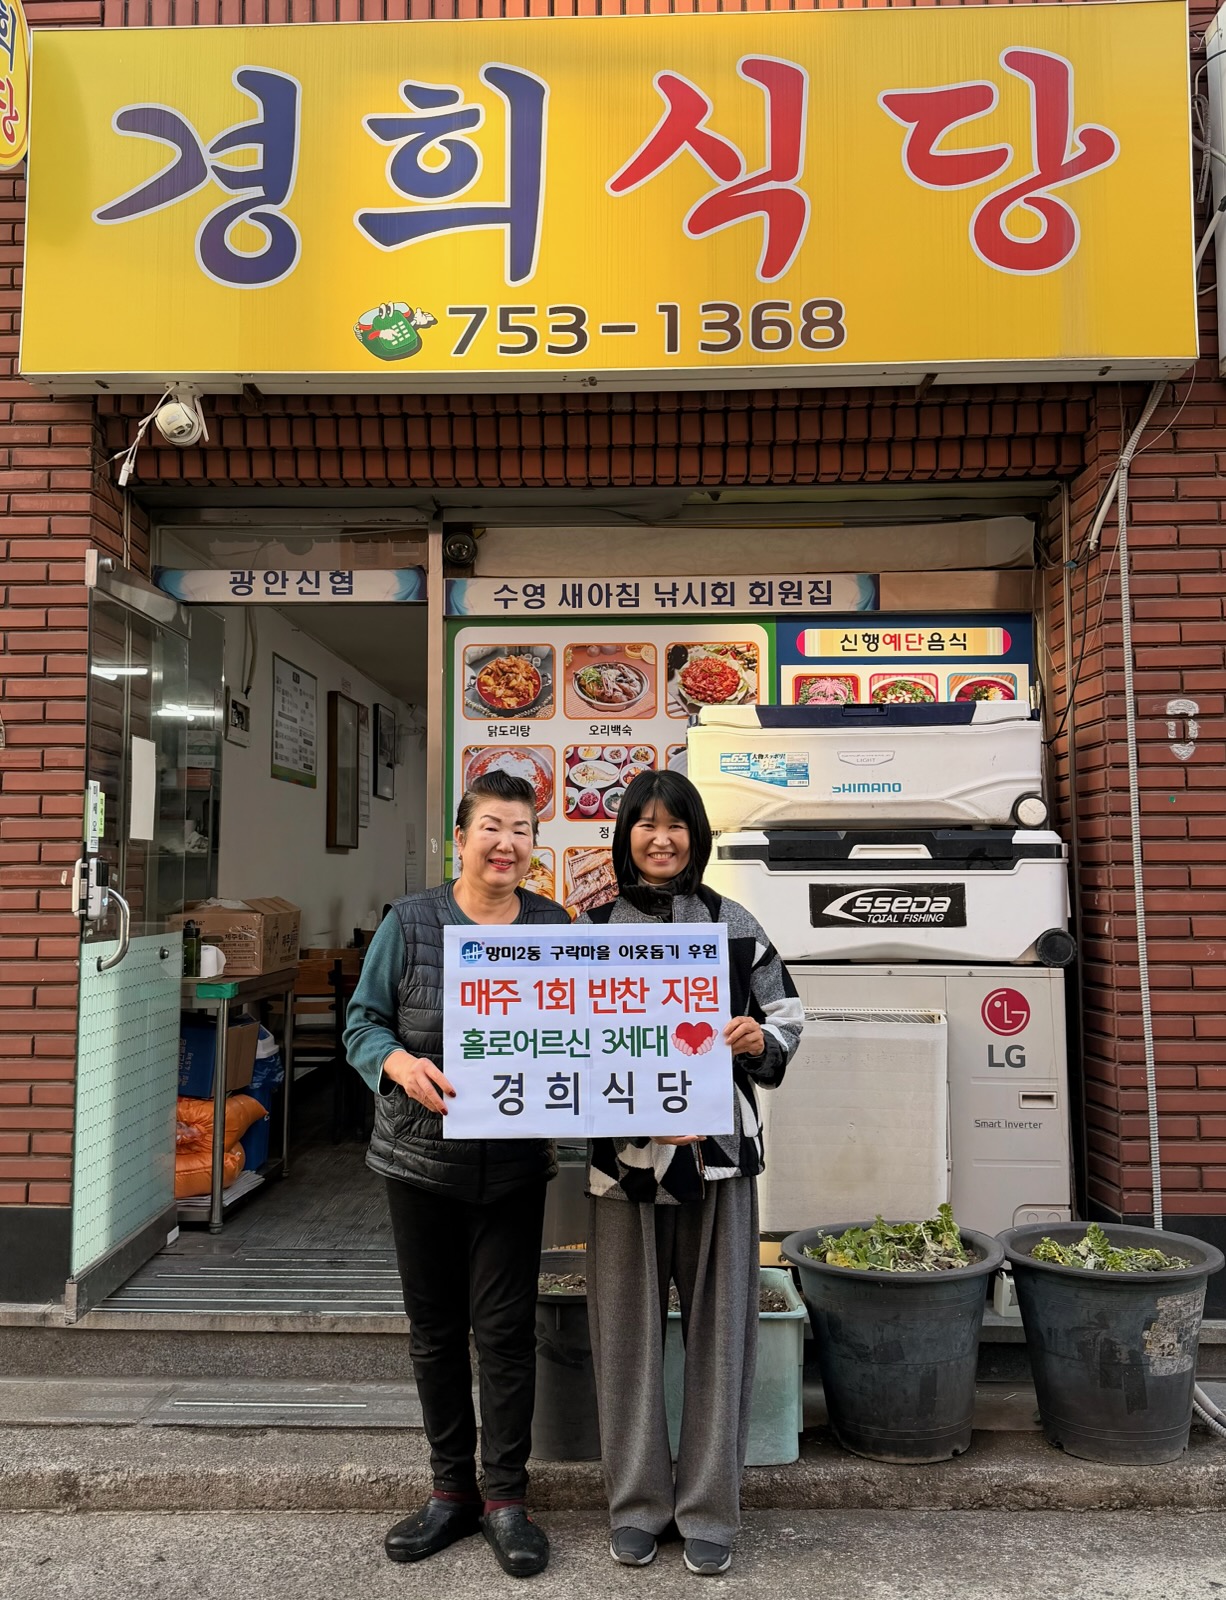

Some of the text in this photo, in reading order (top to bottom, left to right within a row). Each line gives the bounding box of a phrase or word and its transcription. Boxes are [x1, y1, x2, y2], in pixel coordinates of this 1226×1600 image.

[92, 46, 1120, 289] 경희식당
[447, 298, 846, 356] 753-1368
[229, 570, 353, 596] 광안신협
[493, 580, 832, 609] 수영 새아침 낚시회 회원집
[840, 632, 967, 652] 신행예단음식
[487, 724, 633, 737] 닭도리탕 오리백숙
[832, 782, 902, 793] SHIMANO
[599, 826, 616, 839] 정
[868, 914, 945, 923] TOTAL FISHING
[485, 944, 717, 961] 망미2동 구락마을 이웃돕기 후원
[461, 976, 719, 1015] 매주 1회 반찬 지원
[460, 1025, 668, 1060] 홀로어르신 3세대
[988, 1044, 1026, 1068] LG
[974, 1119, 1043, 1129] Smart Inverter
